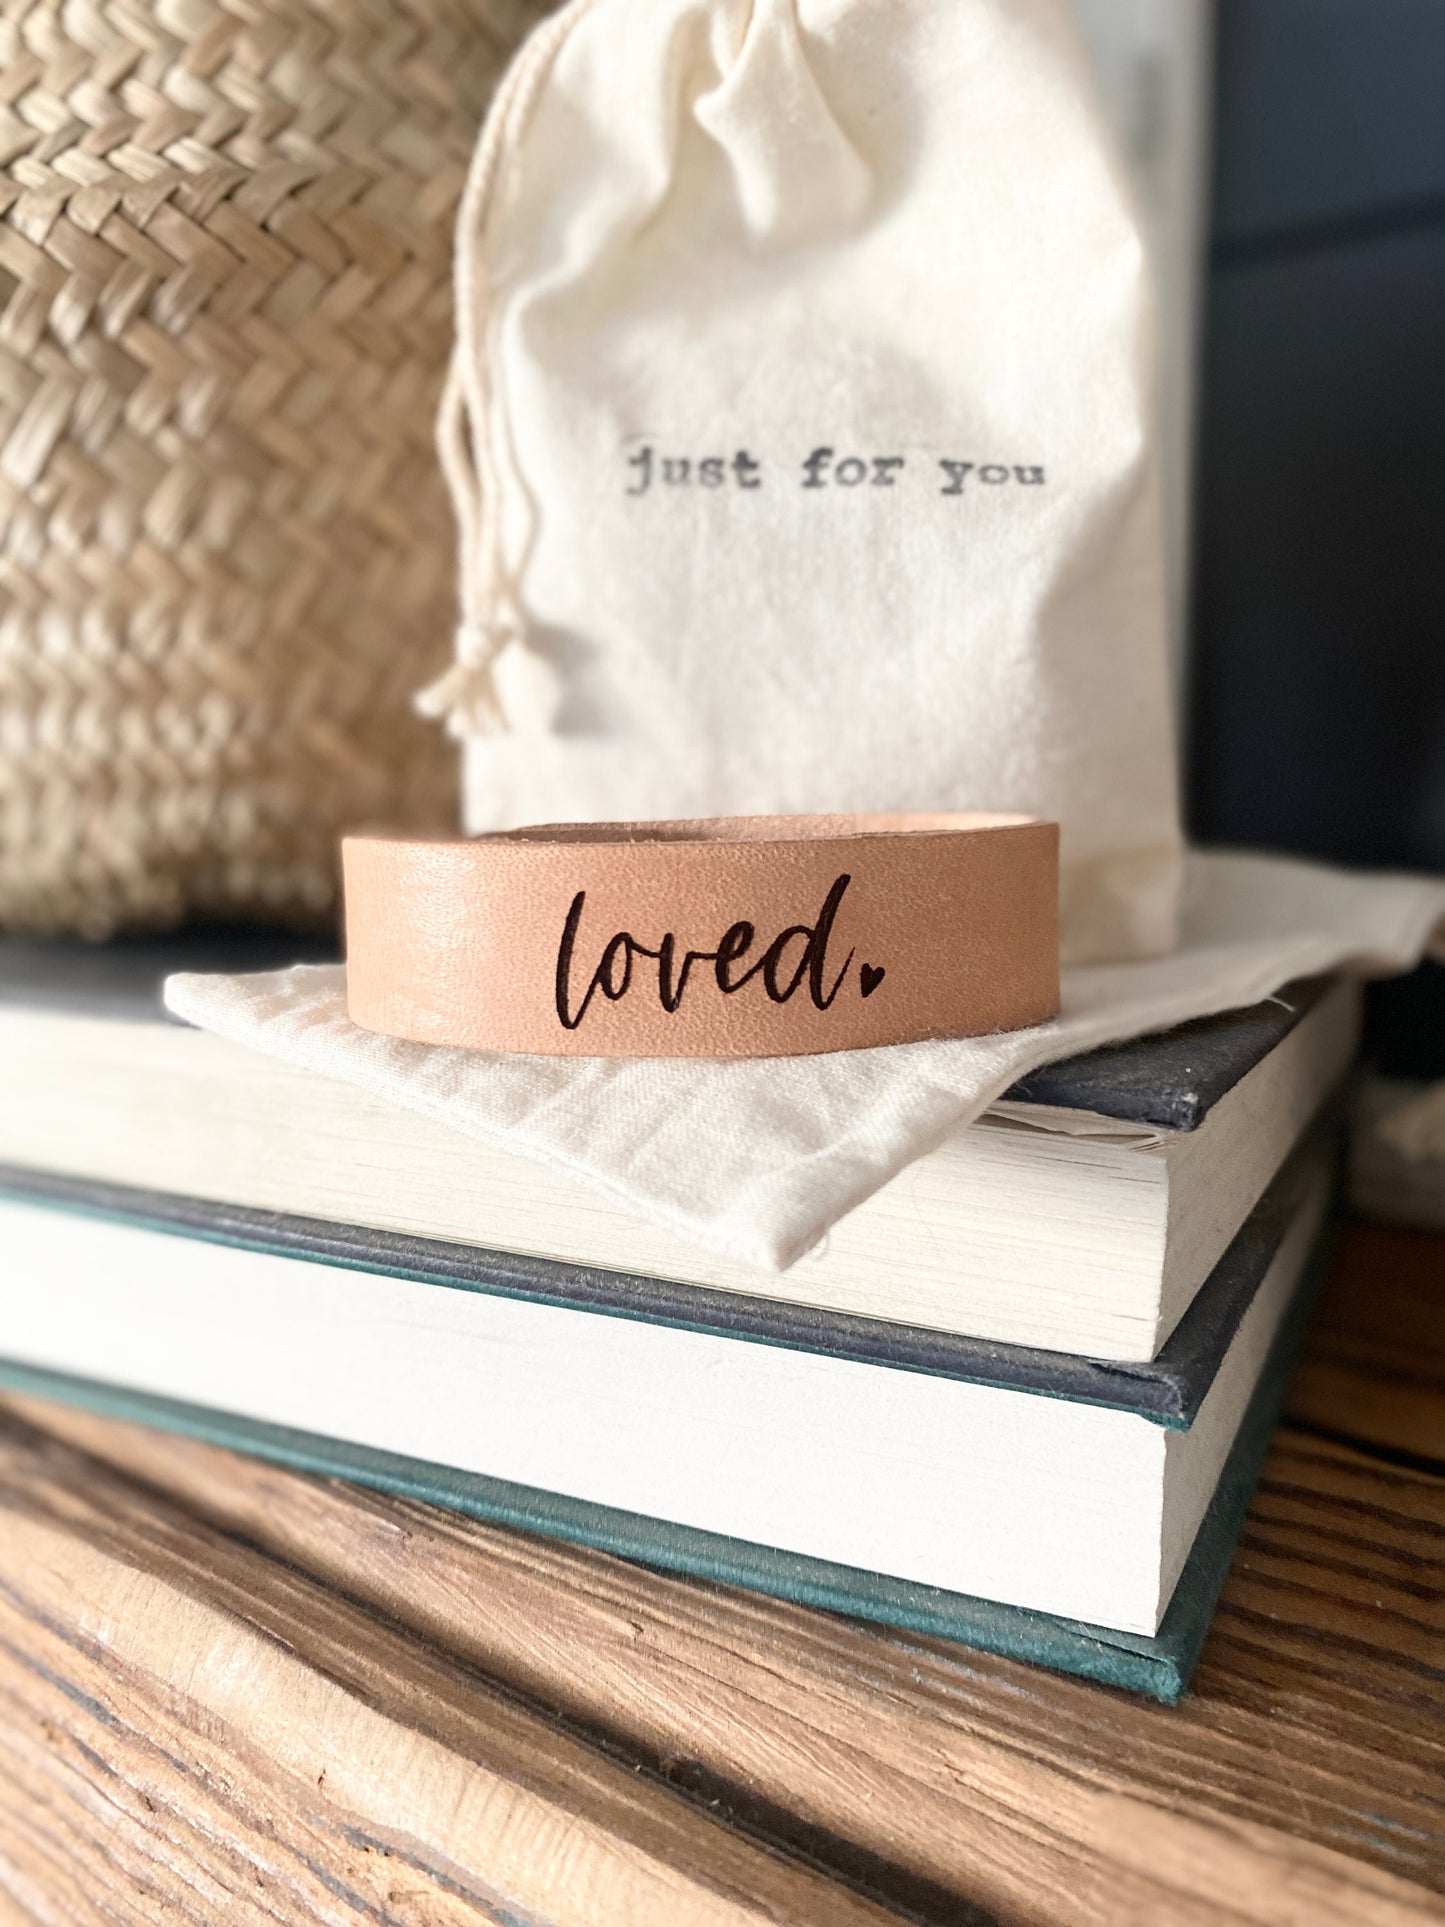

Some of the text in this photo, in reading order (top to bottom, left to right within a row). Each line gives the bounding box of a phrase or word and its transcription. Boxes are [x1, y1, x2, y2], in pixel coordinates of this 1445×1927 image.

[626, 446, 1046, 496] just for you
[555, 872, 857, 1030] loved
